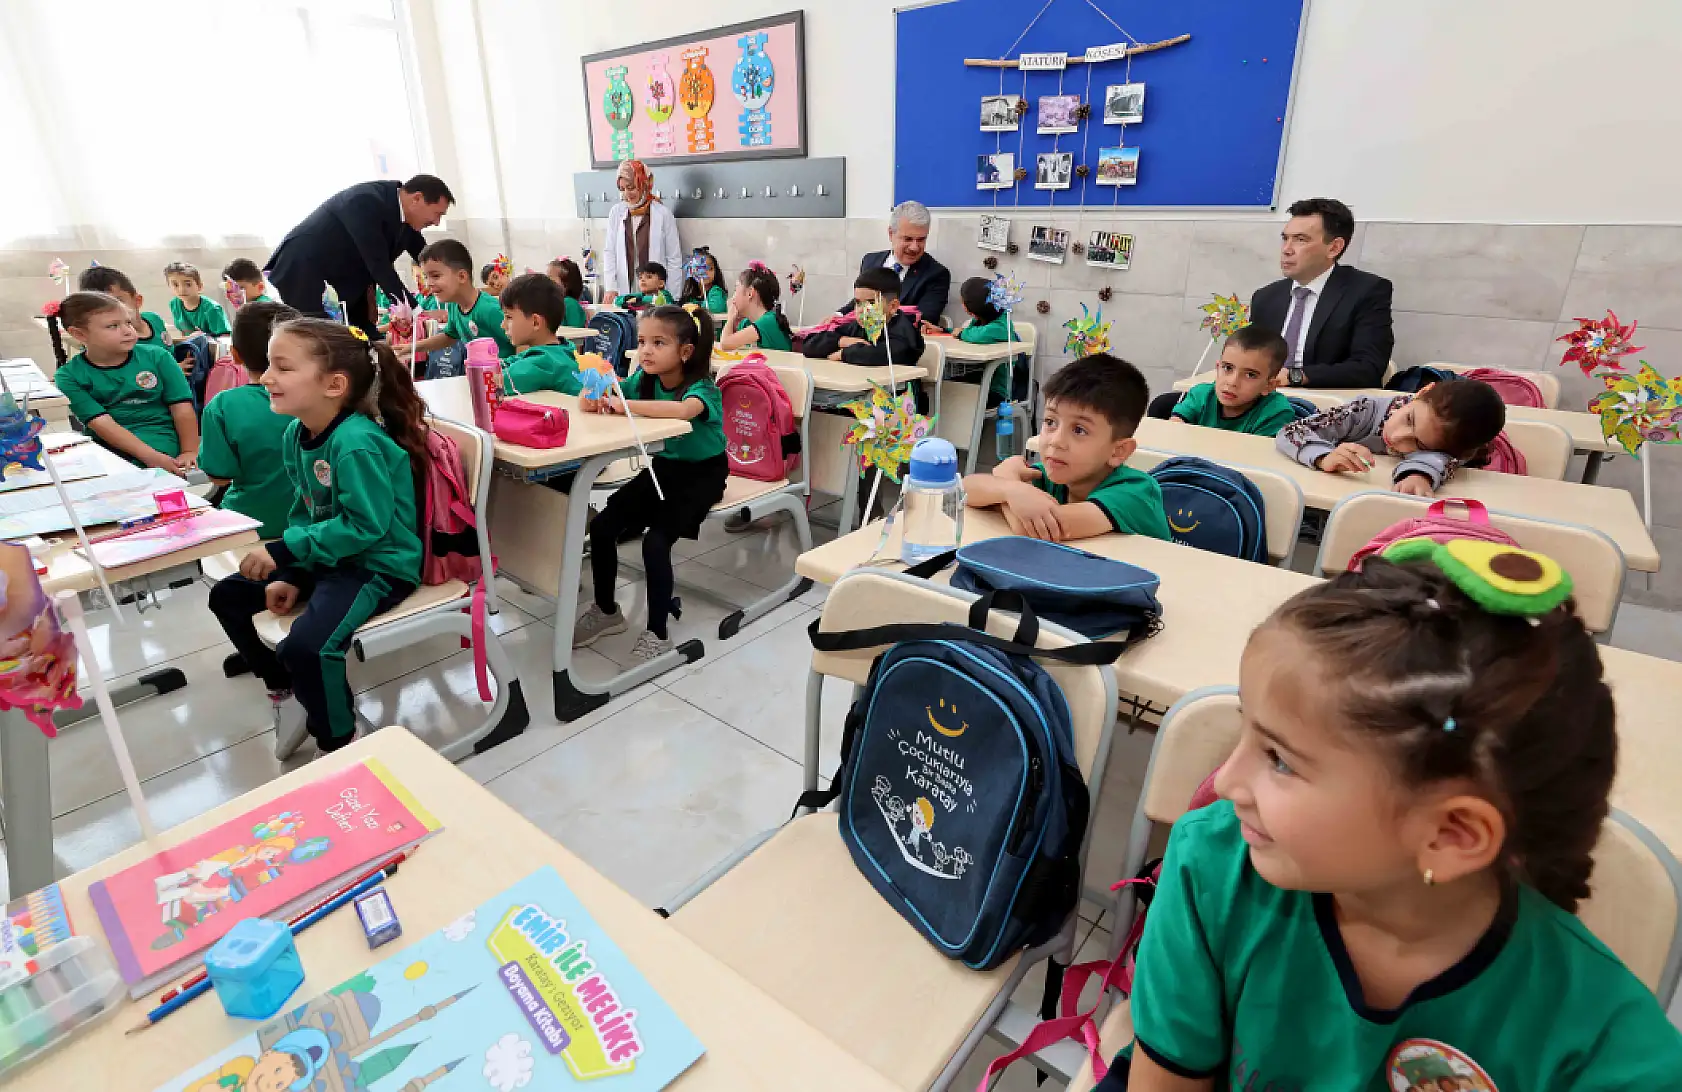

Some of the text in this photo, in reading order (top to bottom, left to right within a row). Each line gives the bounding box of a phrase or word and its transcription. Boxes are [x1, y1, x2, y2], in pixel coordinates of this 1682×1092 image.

[915, 729, 965, 770] Mutlu
[905, 764, 958, 813] Karatay
[503, 964, 564, 1048] Boyama Kitabı
[512, 906, 640, 1063] EMİR İLE MELİKE
